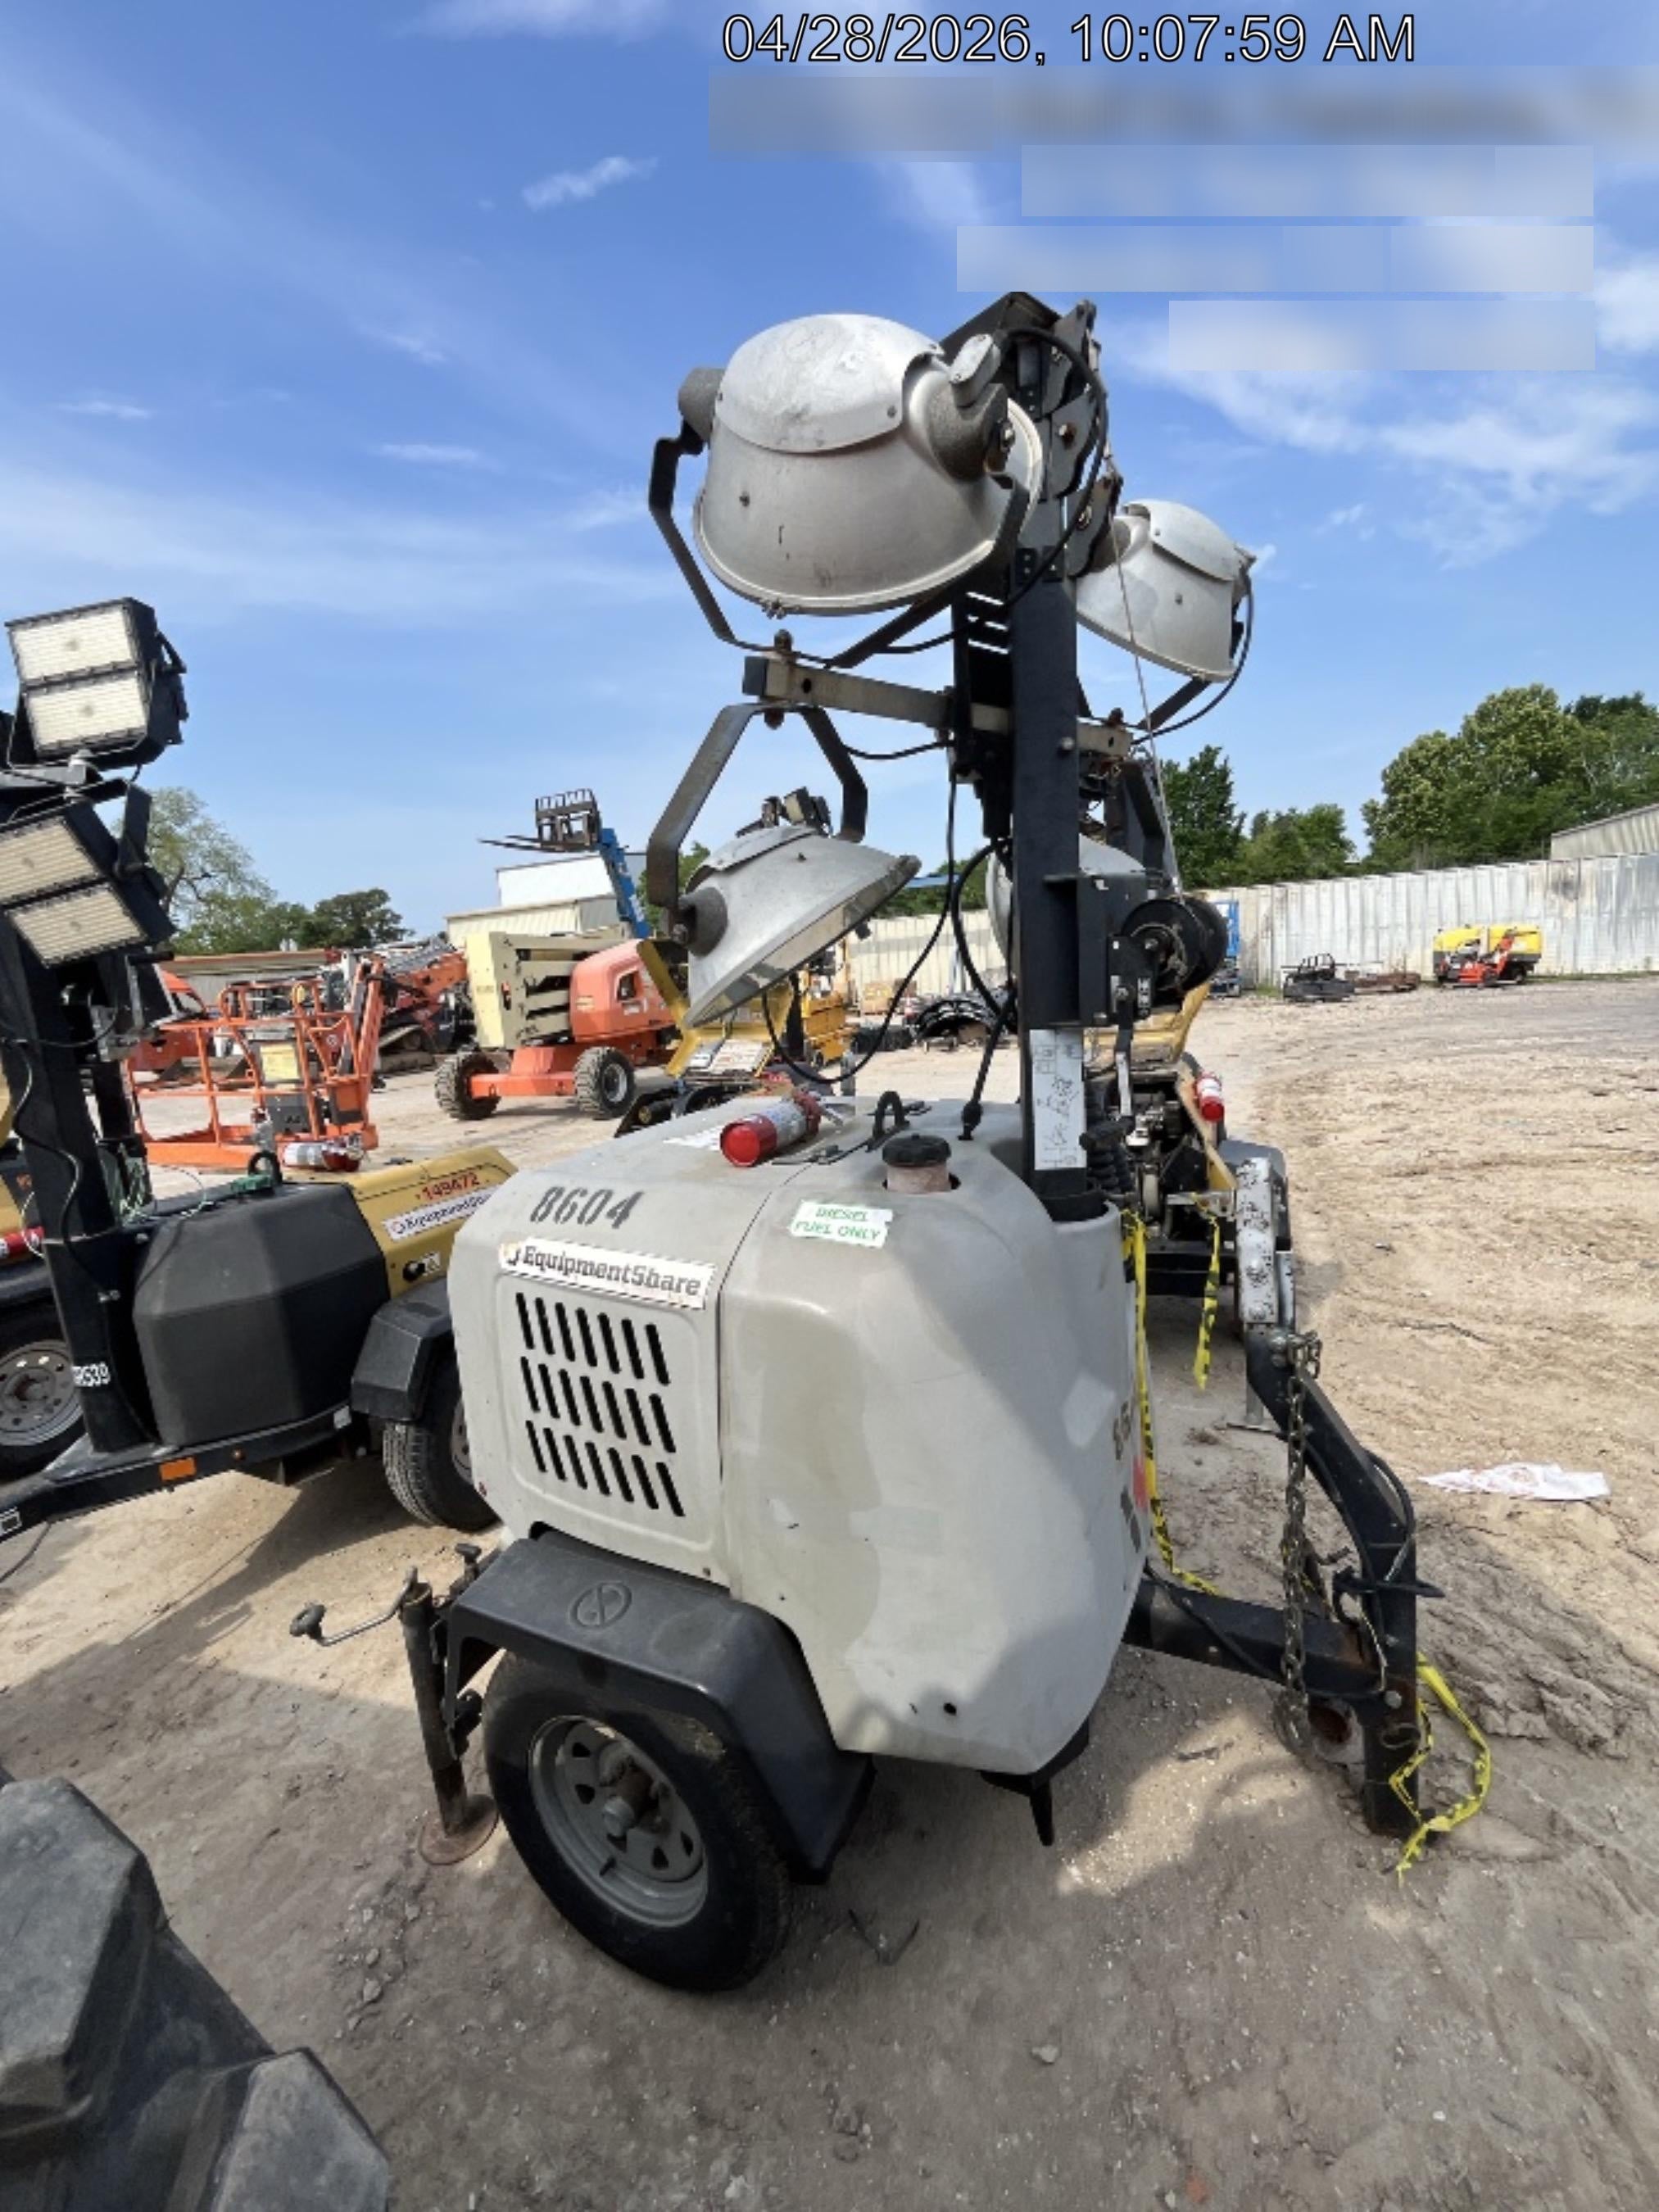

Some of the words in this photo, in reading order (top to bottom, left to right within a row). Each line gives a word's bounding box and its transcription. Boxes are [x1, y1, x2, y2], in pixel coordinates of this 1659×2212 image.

[530, 1186, 645, 1229] 8604
[815, 1207, 868, 1222] DIESEL
[795, 1221, 832, 1235] FUEL
[837, 1226, 882, 1240] ONLY
[523, 1245, 701, 1295] EquipmentShare
